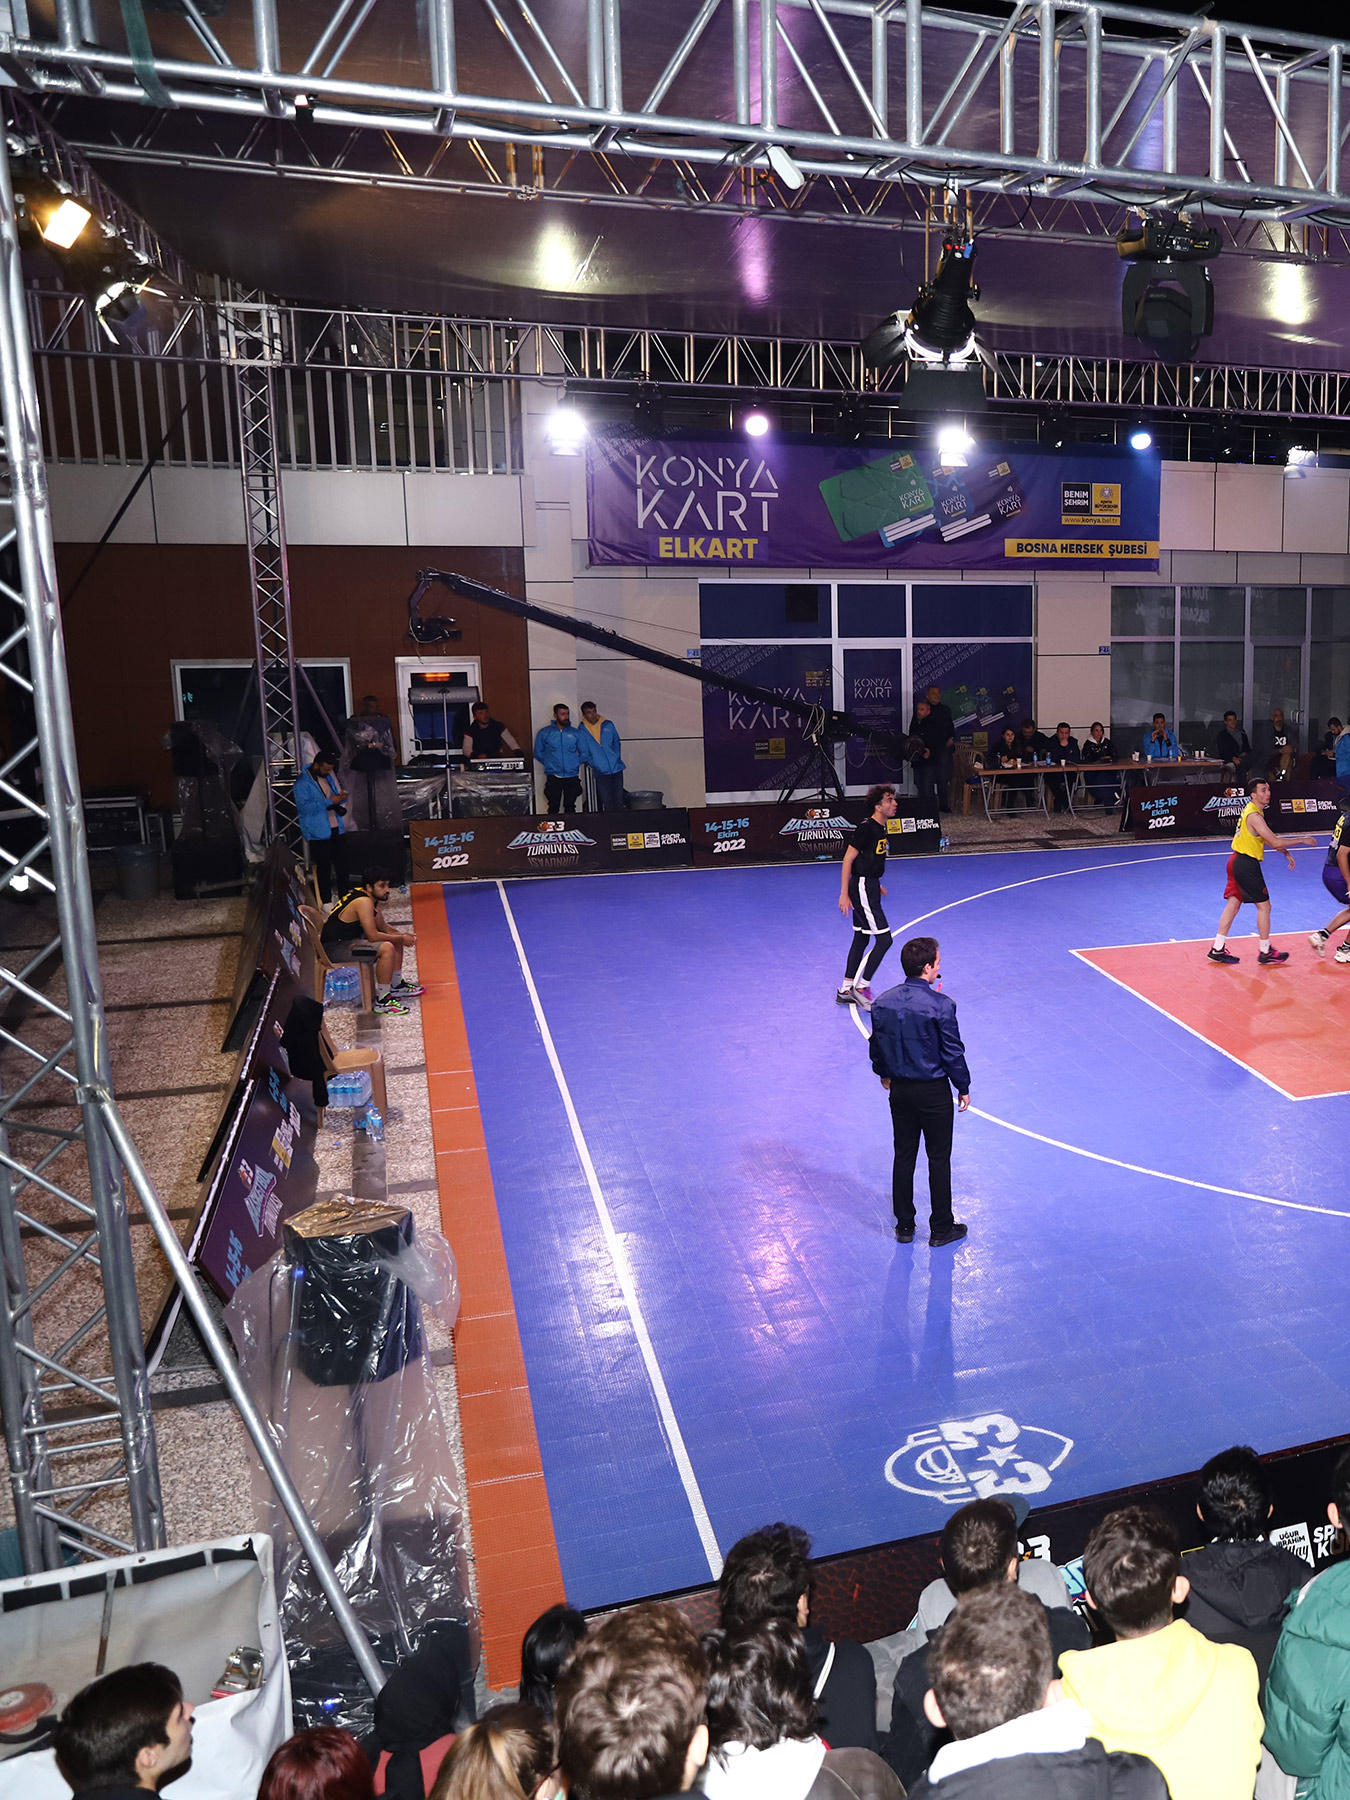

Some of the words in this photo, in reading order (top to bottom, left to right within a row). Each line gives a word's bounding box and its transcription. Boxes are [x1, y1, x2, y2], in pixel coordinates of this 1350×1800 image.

[636, 455, 779, 489] KONYA
[637, 489, 779, 532] KART
[659, 537, 759, 559] ELKART
[1016, 543, 1058, 553] BOSNA
[1060, 543, 1104, 554] HERSEK
[1108, 542, 1148, 557] ŞUBESİ
[853, 678, 893, 688] KONYA
[854, 687, 893, 699] KART
[1140, 796, 1178, 811] 14-15-16
[1151, 807, 1170, 817] Ekim
[704, 817, 750, 833] 14-15-16
[779, 816, 858, 834] BASKETBOL
[1148, 815, 1176, 829] 2022
[424, 831, 475, 848] 14-15-16
[507, 829, 597, 849] BASKETBOL
[717, 829, 739, 840] Ekim
[797, 830, 844, 841] TURNUVASI
[437, 844, 462, 854] Ekim
[527, 844, 579, 856] TURNUVASI
[712, 838, 746, 853] 2022
[431, 853, 470, 869] 2022
[1278, 1530, 1300, 1540] UĞUR
